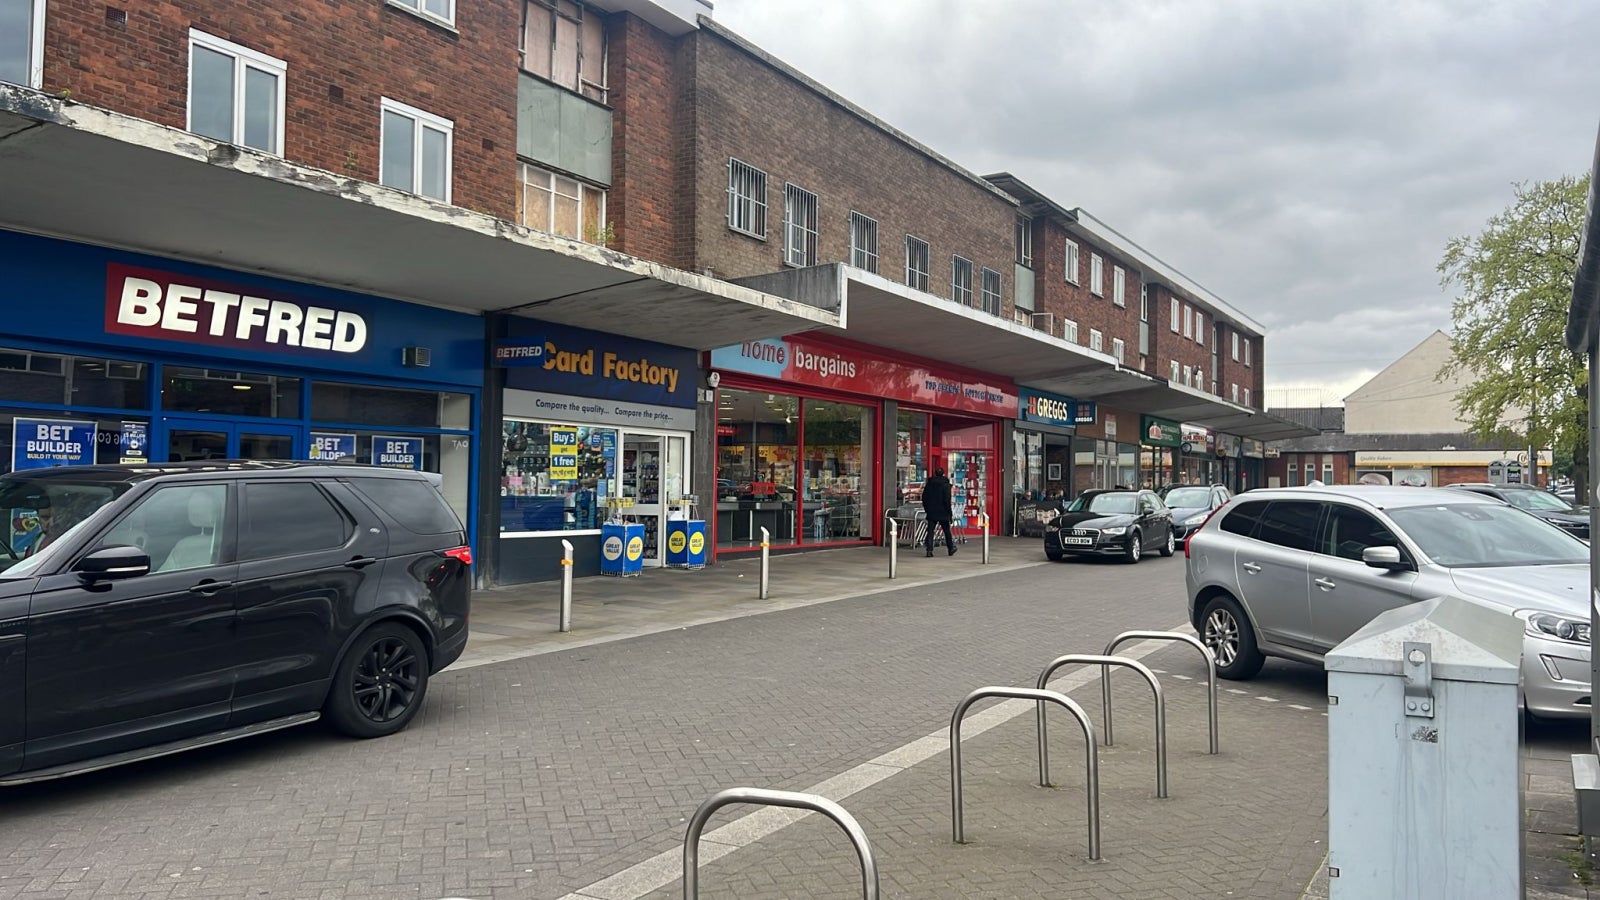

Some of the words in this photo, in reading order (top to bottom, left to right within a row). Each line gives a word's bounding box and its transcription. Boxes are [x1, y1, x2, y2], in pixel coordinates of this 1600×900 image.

[117, 277, 367, 353] BETFRED
[496, 346, 542, 358] BETFRED
[543, 341, 594, 375] Card
[603, 352, 679, 393] Factory
[795, 346, 856, 378] bargains
[535, 399, 567, 411] Compare
[569, 402, 580, 411] the
[615, 407, 642, 417] Compare
[643, 409, 653, 418] the
[1037, 397, 1068, 421] GREGGS
[37, 424, 73, 441] BET
[553, 433, 569, 445] Buy
[569, 433, 575, 442] 3
[27, 441, 82, 453] BUILDER
[316, 437, 341, 451] BET
[386, 441, 409, 454] BET
[381, 454, 414, 463] BUILDER
[554, 457, 558, 466] 1
[559, 456, 575, 466] free
